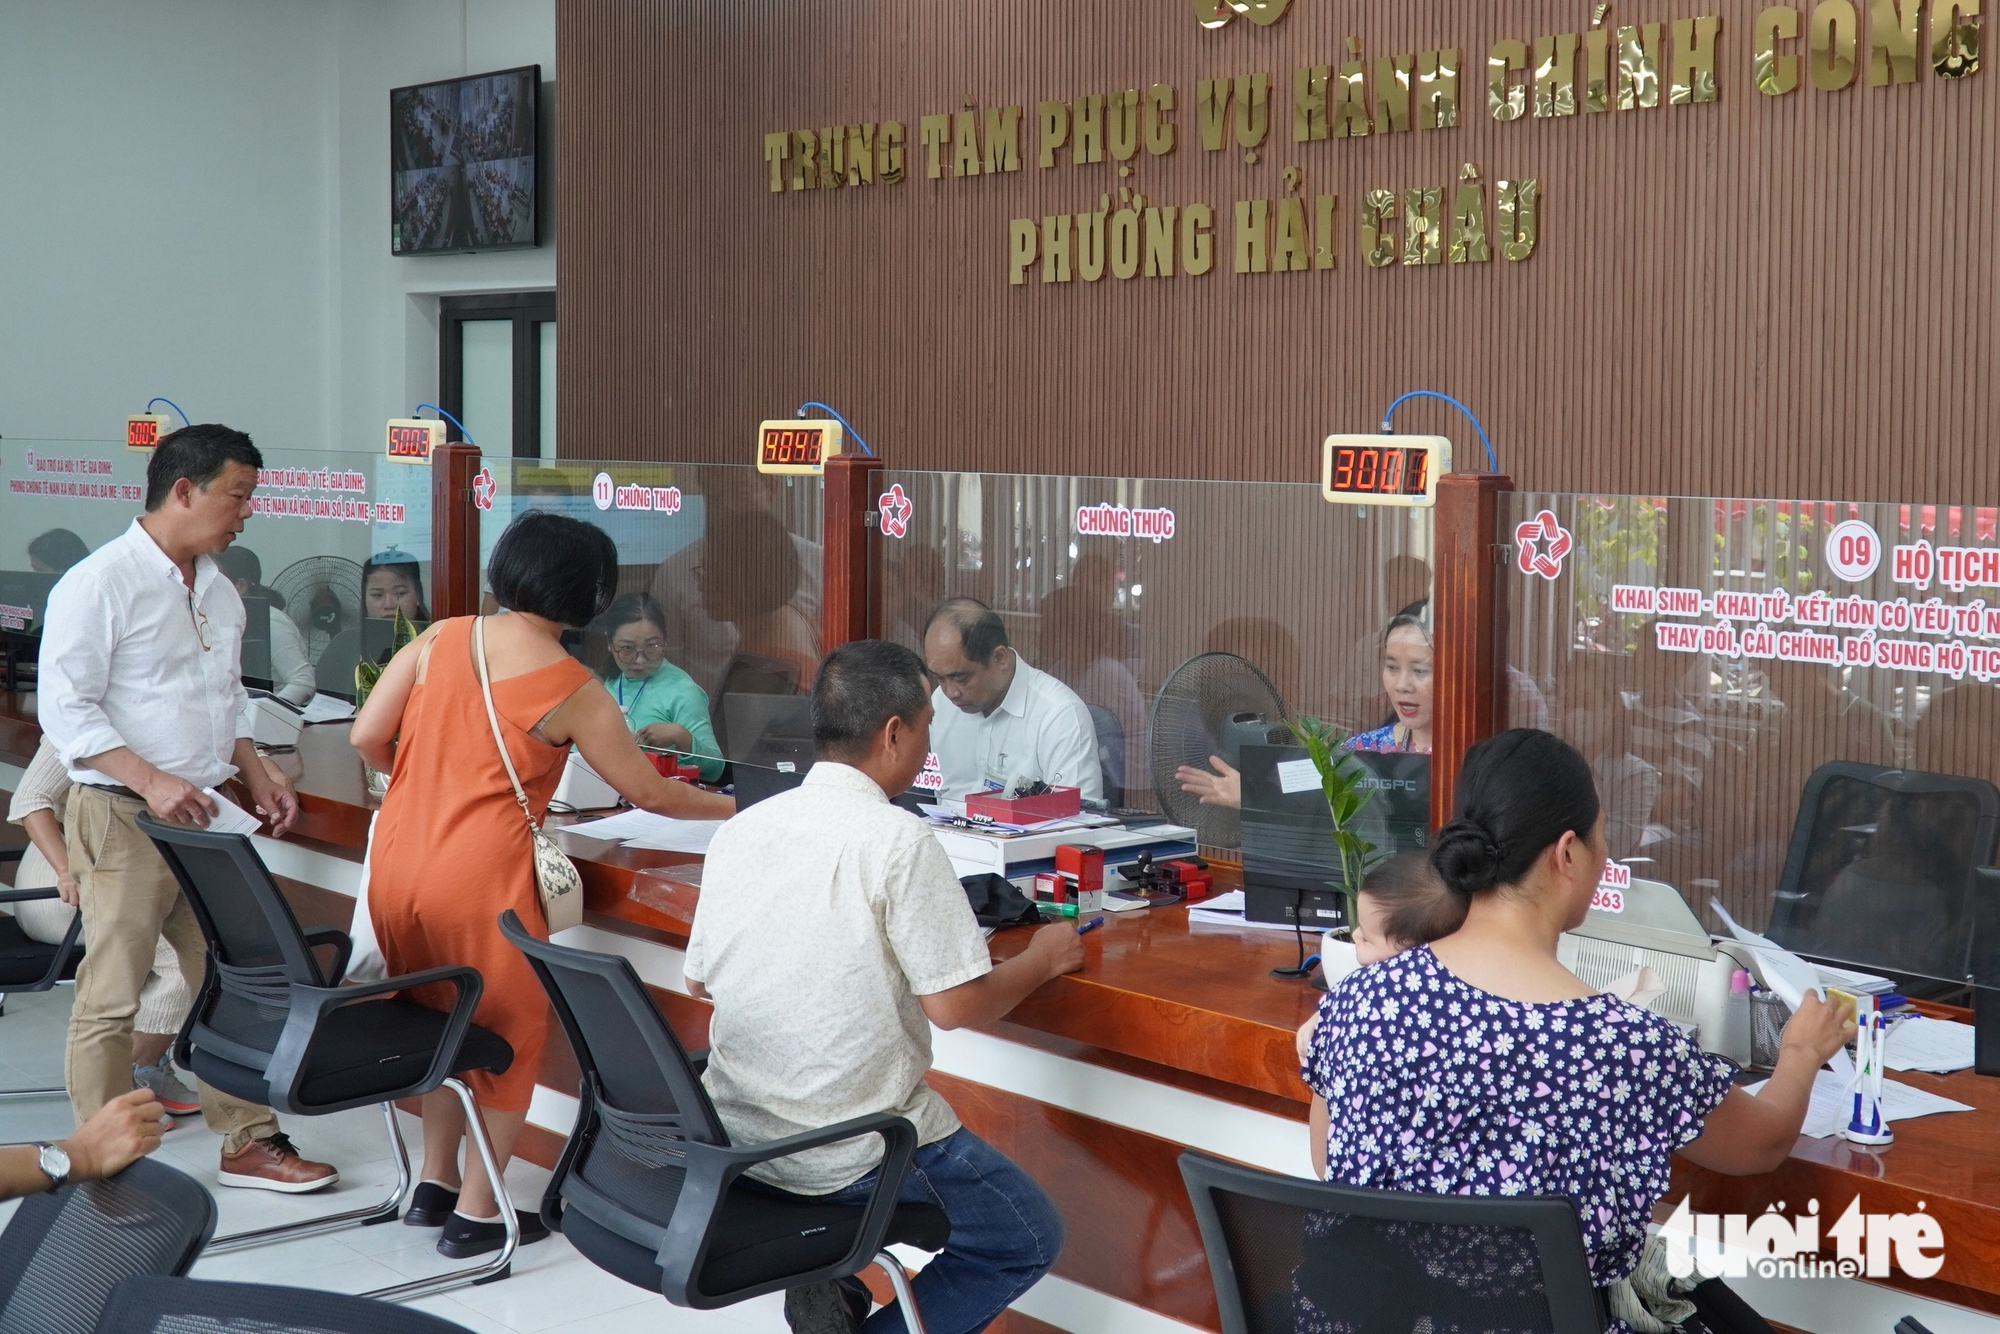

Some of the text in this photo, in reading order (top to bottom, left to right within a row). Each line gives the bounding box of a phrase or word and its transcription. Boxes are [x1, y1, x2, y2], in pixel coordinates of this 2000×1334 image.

[764, 121, 906, 192] TRUNG
[920, 93, 1023, 180] TÂM
[1039, 83, 1178, 178] PHỤC
[1197, 72, 1273, 164] VỤ
[1292, 36, 1462, 142] HÀNH
[1487, 3, 1724, 122] CHÍNH
[1009, 162, 1541, 285] PHƯỜNG HẢI CHÂU
[129, 422, 157, 445] 6005
[390, 428, 430, 456] 5003
[271, 469, 284, 489] TRỢ
[285, 468, 295, 486] XÃ
[330, 473, 343, 489] GIA
[1334, 449, 1428, 491] 3001
[132, 485, 141, 500] EM
[597, 482, 608, 500] 11
[617, 485, 651, 508] CHỨNG
[653, 487, 680, 513] THỰC
[262, 494, 270, 516] TỆ
[272, 498, 287, 517] NẠN
[288, 496, 298, 514] XÃ
[315, 497, 329, 516] DÂN
[346, 499, 355, 518] BÀ
[357, 503, 369, 524] MẸ
[376, 499, 390, 521] TRẺ
[392, 505, 404, 522] EM
[1079, 505, 1173, 540] CHỨNG THỰC
[1839, 535, 1871, 566] 09
[1896, 543, 1999, 589] HỘ TỊCH
[1615, 588, 1653, 610] KHAI
[1658, 590, 1699, 613] SINH
[1716, 594, 1757, 617] KHAI
[1797, 593, 1830, 622] KẾT
[1836, 598, 1875, 625] HÔN
[1881, 601, 1907, 628] CÓ
[1913, 601, 1950, 631] YẾU
[1956, 602, 1980, 633] TỐ
[1659, 626, 1699, 648] THAY
[1704, 622, 1738, 654] ĐỔI,
[1744, 625, 1773, 655] CẢI
[1779, 632, 1840, 662] CHÍNH,
[1847, 632, 1873, 663] BỔ
[1878, 642, 1931, 668] SUNG
[1937, 643, 1963, 675] HỘ
